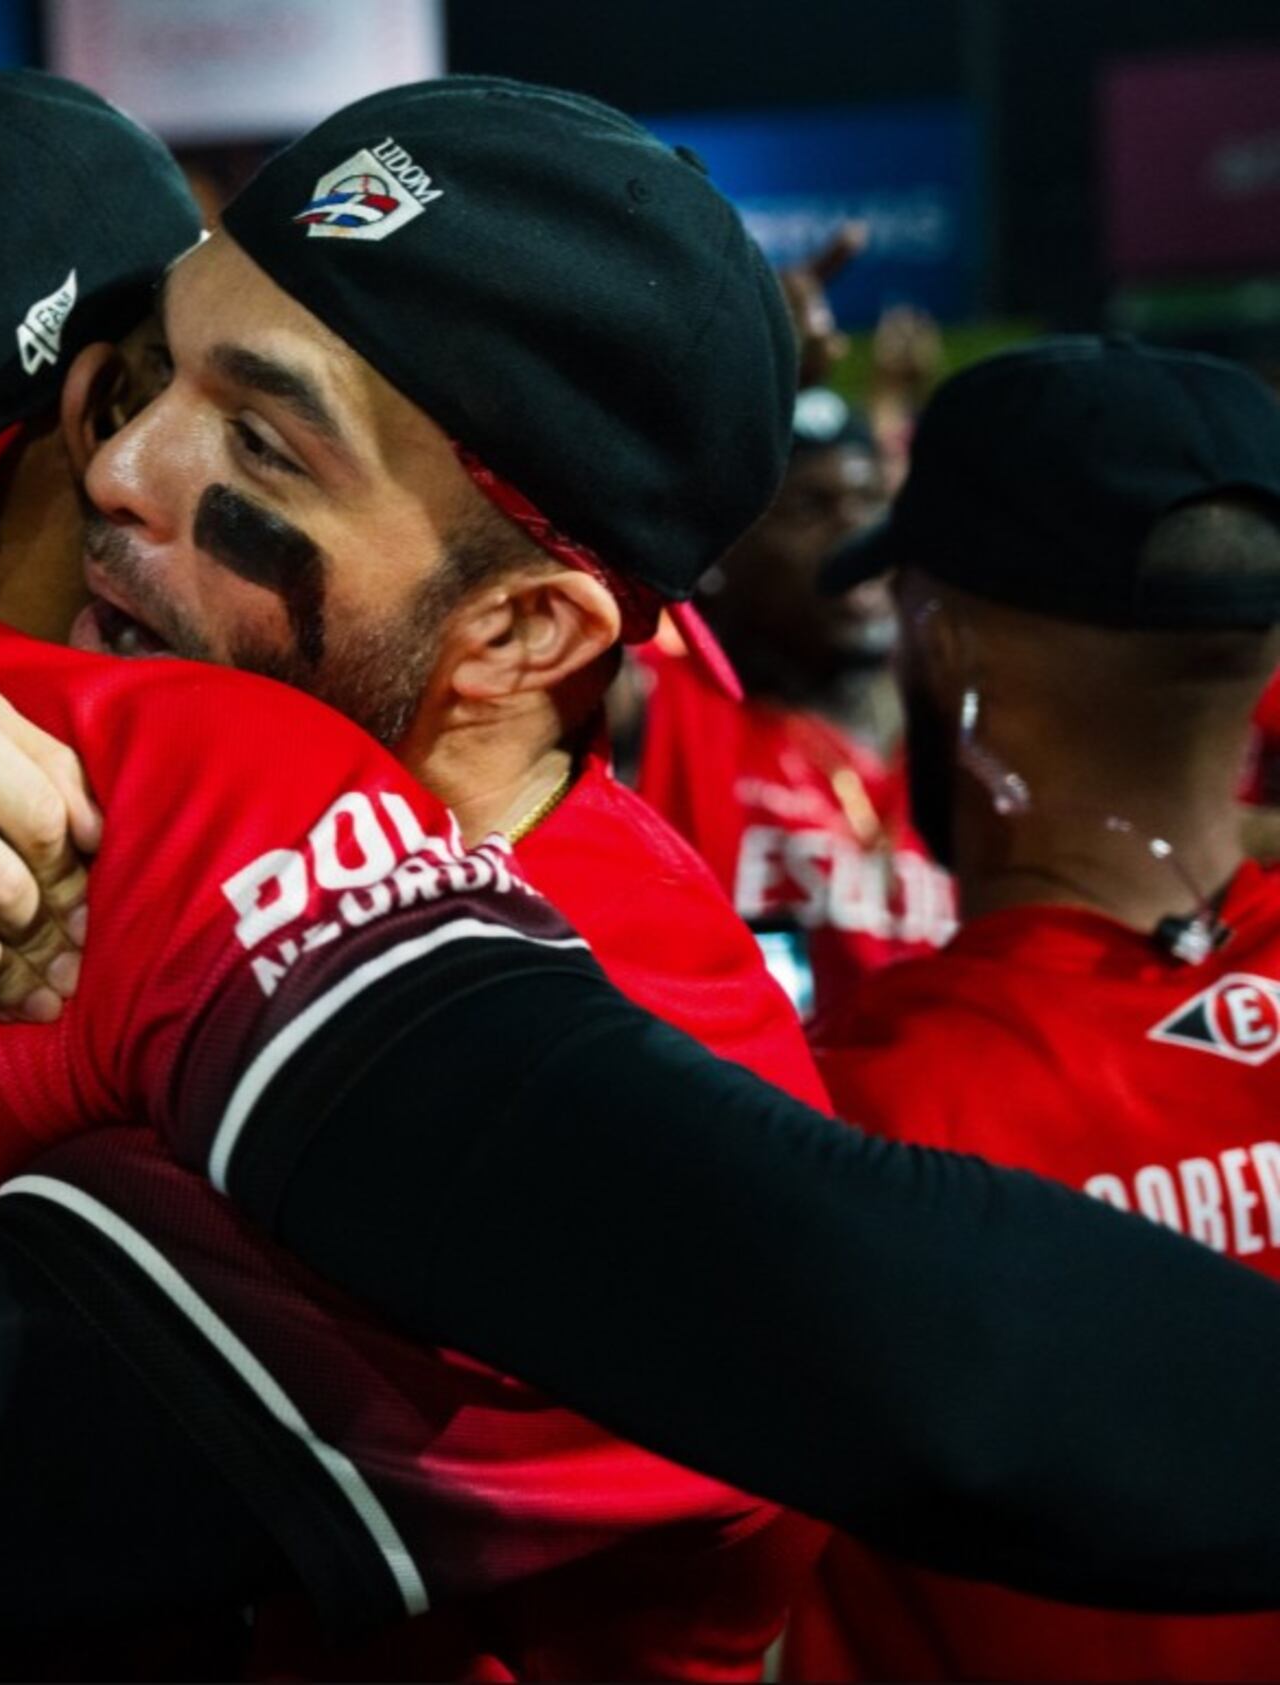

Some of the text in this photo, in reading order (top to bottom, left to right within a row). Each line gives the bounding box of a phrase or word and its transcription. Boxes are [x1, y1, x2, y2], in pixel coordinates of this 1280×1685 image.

[371, 136, 444, 204] LIDOM
[221, 790, 465, 950] DOL
[1226, 985, 1272, 1045] E
